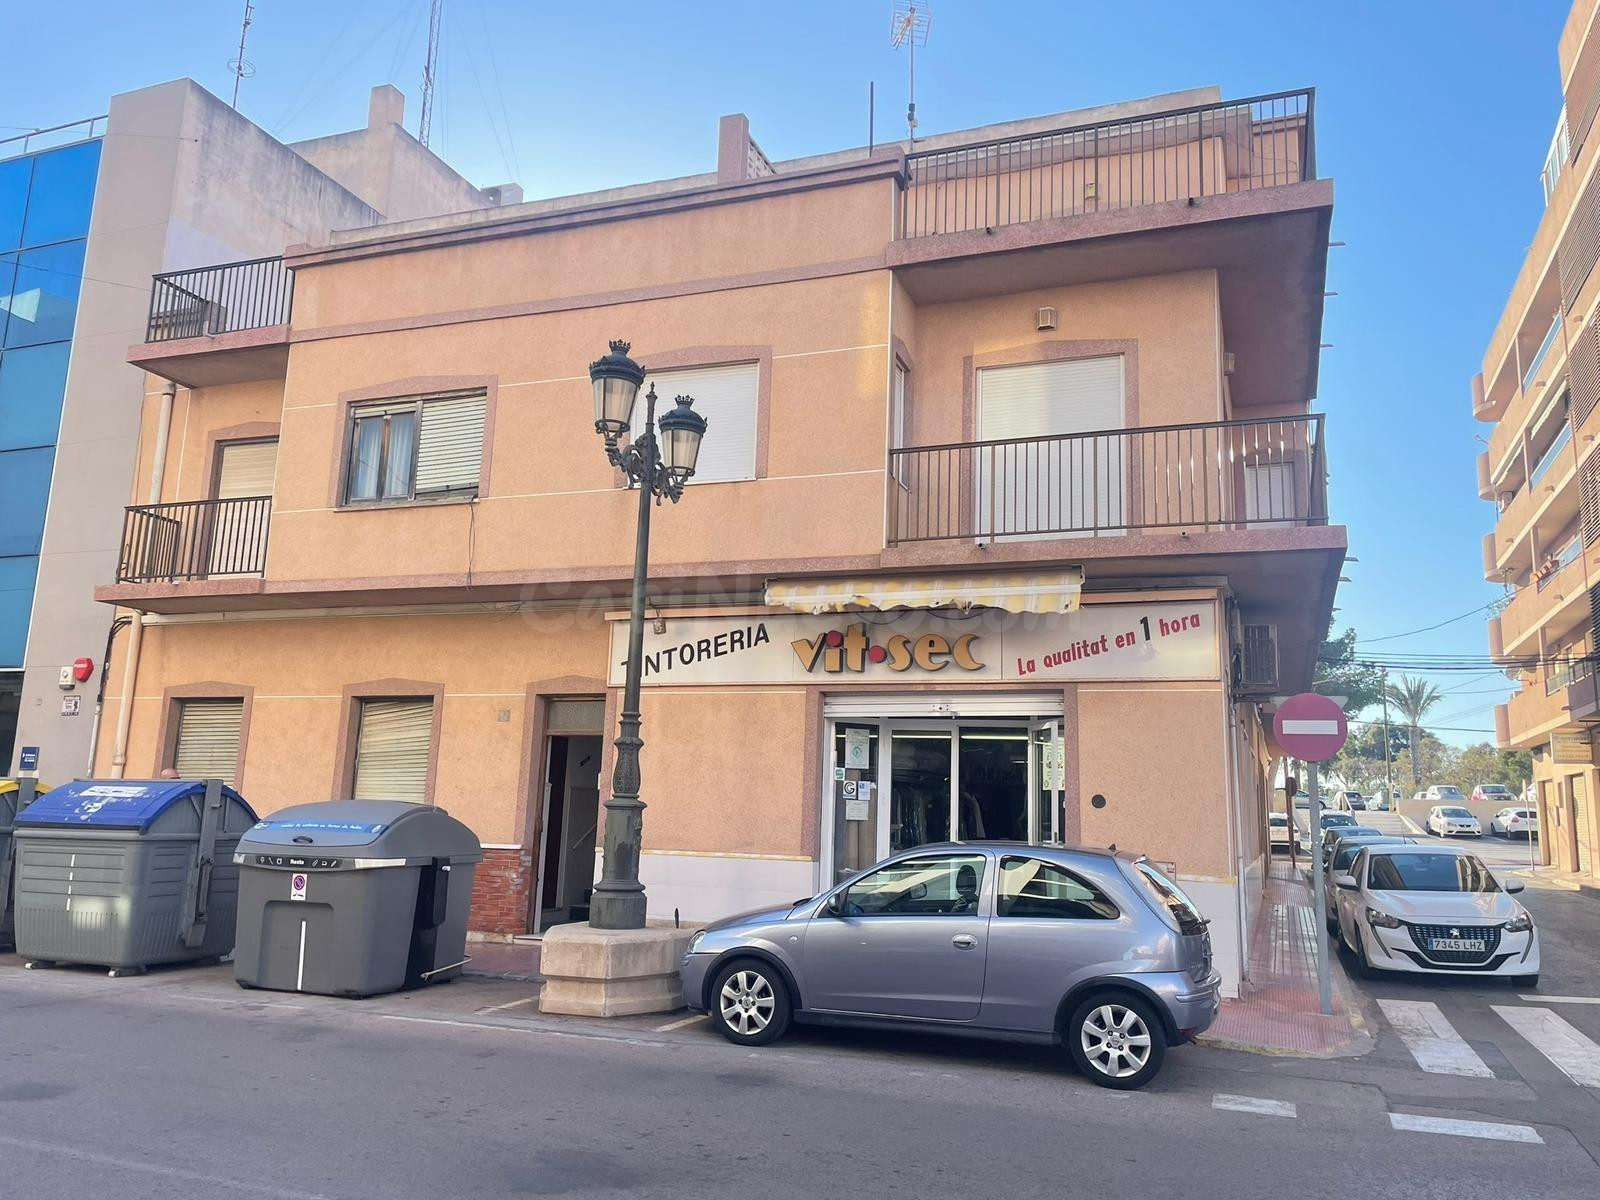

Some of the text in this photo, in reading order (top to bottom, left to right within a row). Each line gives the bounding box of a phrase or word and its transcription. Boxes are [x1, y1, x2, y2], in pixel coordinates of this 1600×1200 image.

[620, 622, 770, 677] NTORERIA
[1017, 613, 1201, 676] La qualitat en 1 hora
[1434, 940, 1483, 951] 7345 LHZ
